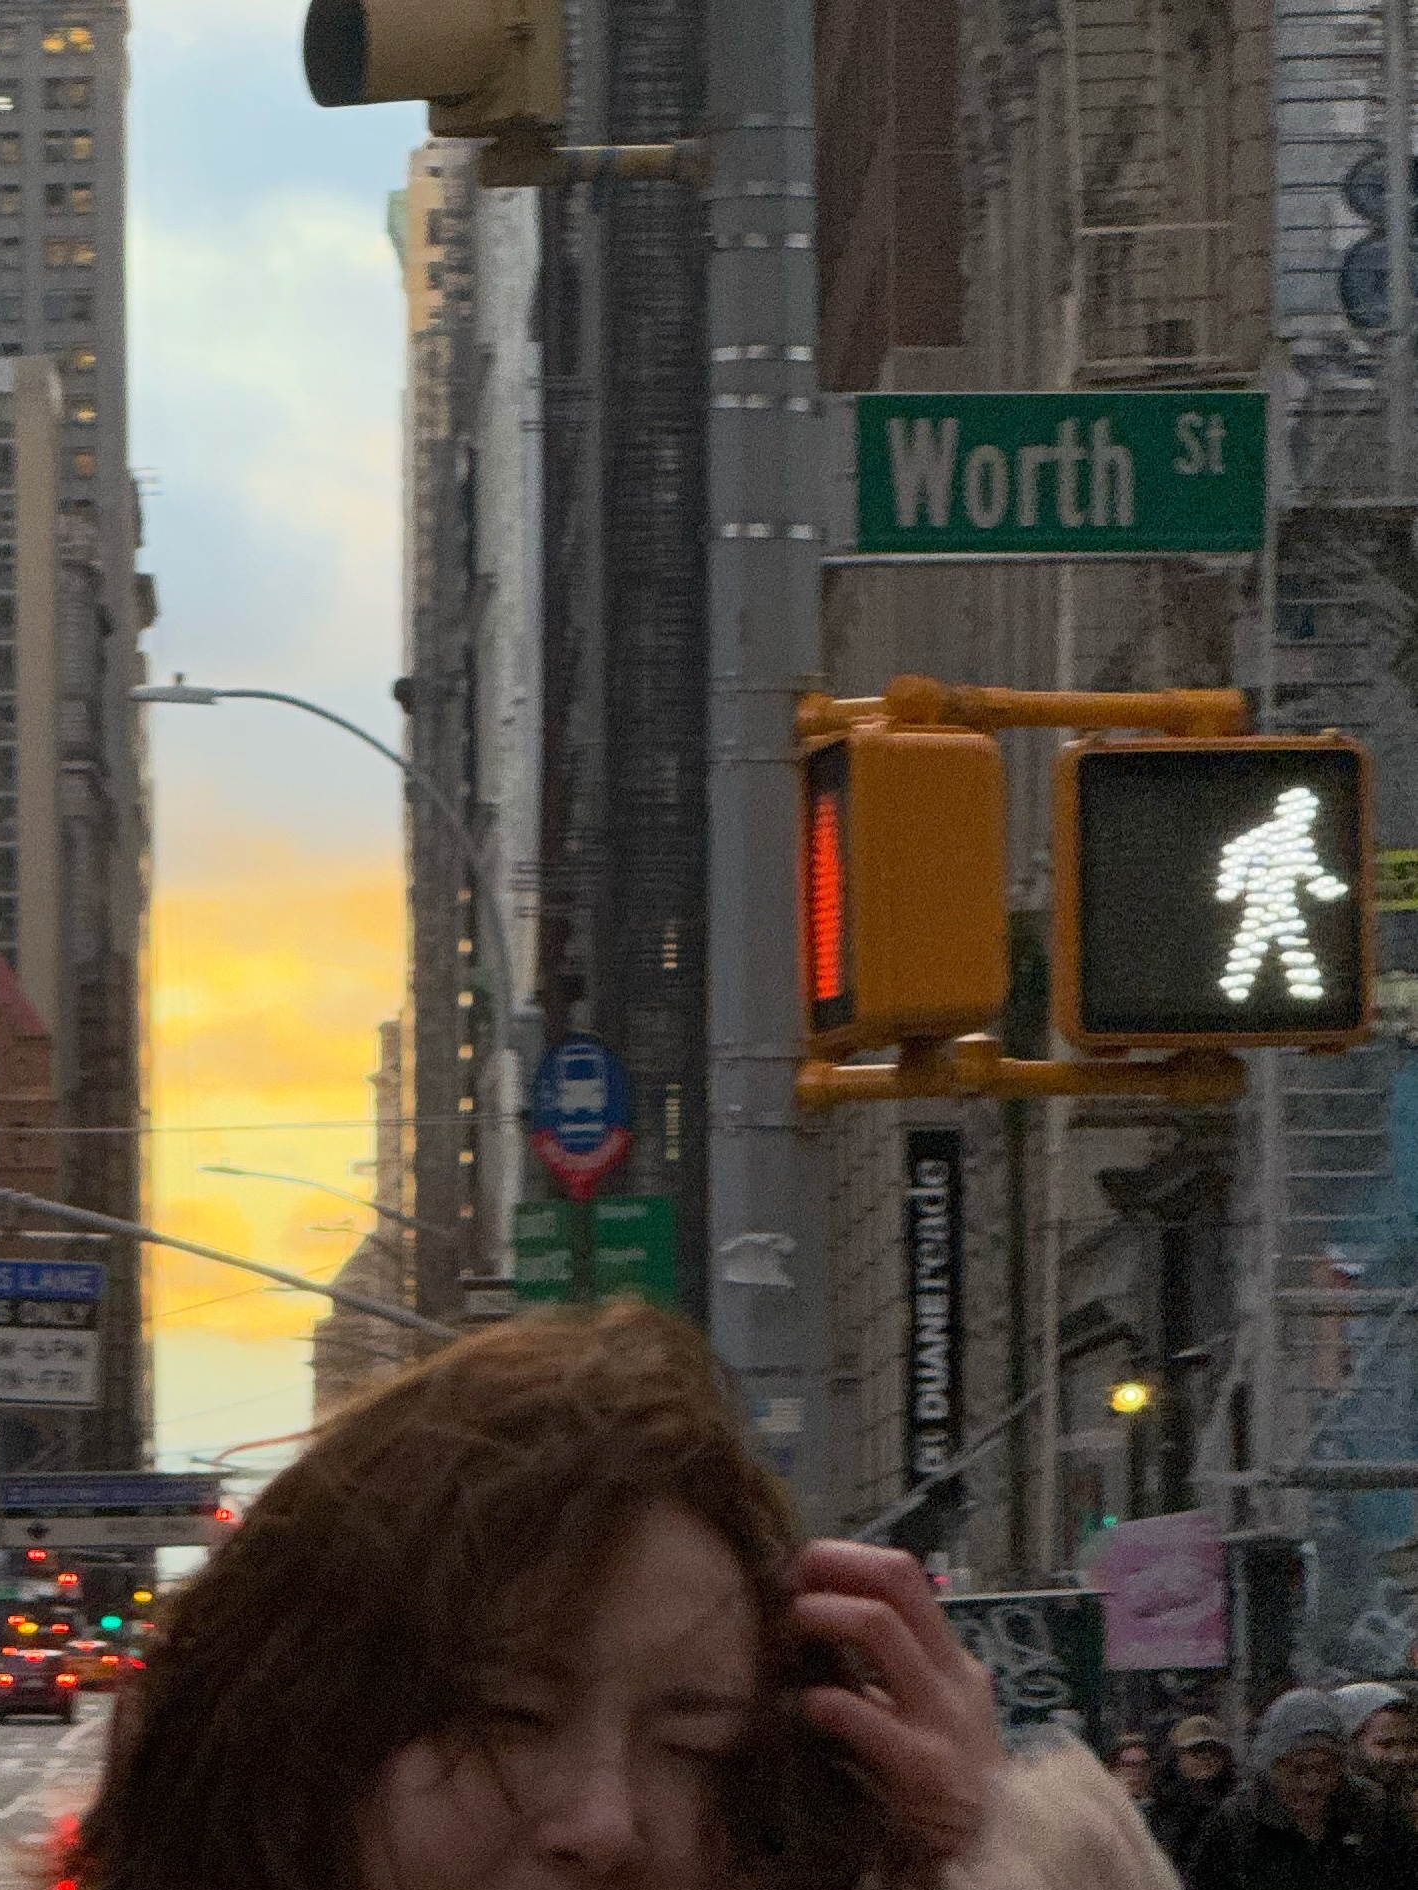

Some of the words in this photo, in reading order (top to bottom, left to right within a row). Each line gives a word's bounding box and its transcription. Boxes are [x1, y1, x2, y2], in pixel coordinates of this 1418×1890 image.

[886, 416, 1135, 528] Worth
[1174, 412, 1227, 475] St
[915, 1296, 949, 1419] DUANE
